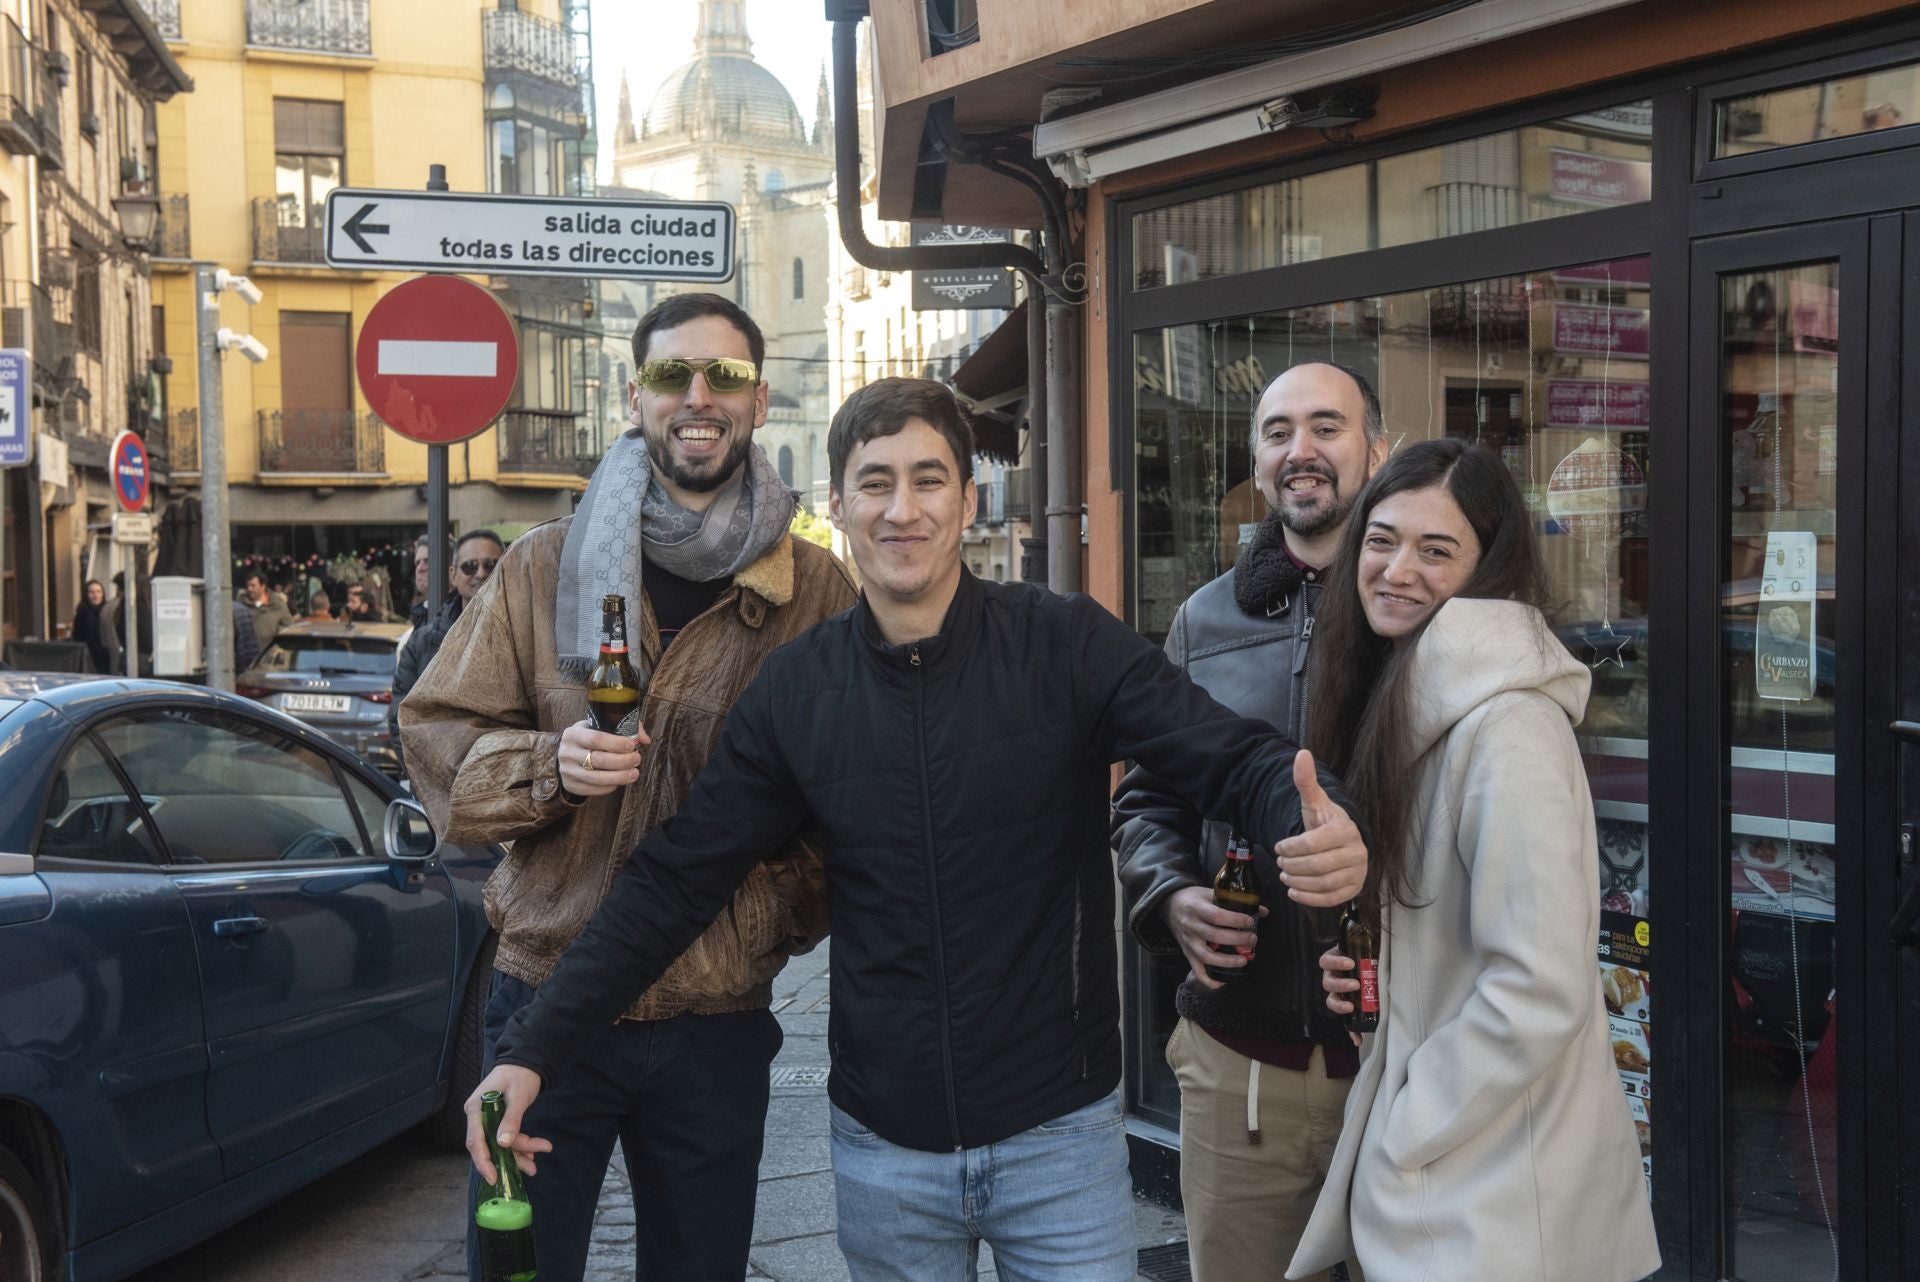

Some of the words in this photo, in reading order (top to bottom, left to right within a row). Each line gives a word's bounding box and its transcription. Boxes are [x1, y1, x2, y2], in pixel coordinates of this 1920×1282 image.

[545, 211, 621, 235] salida
[630, 214, 716, 238] ciudad
[440, 237, 513, 260] todas
[522, 240, 561, 262] las
[569, 241, 715, 267] direcciones
